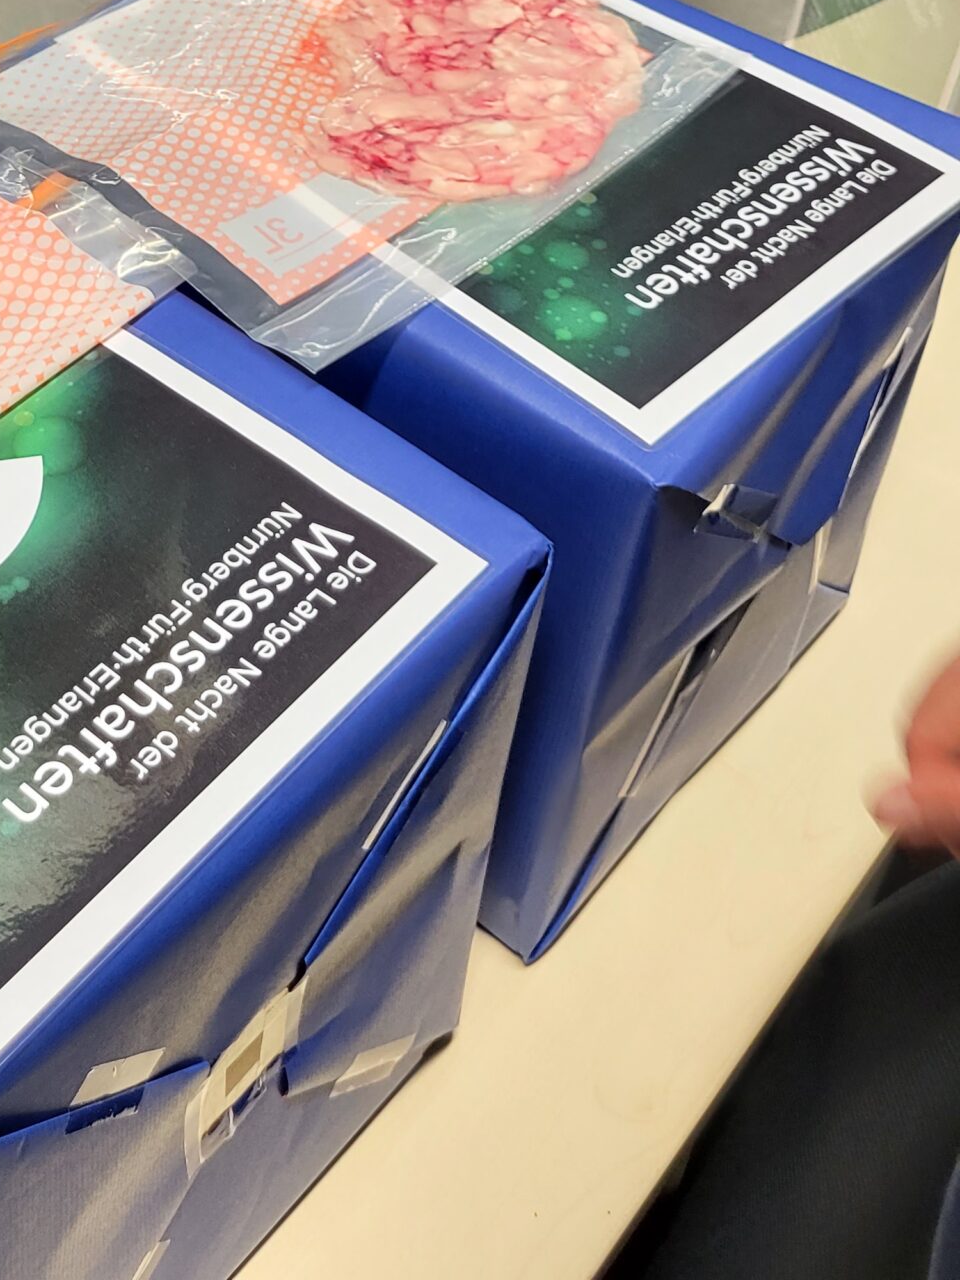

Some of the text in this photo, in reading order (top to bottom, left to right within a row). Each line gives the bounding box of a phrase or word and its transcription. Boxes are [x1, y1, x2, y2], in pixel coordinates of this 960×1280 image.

[624, 138, 877, 309] Wissenschaften
[719, 158, 897, 290] Die Lange Nacht der
[1, 522, 355, 823] Wissenschaften
[130, 549, 377, 780] Die Lange Nacht der
